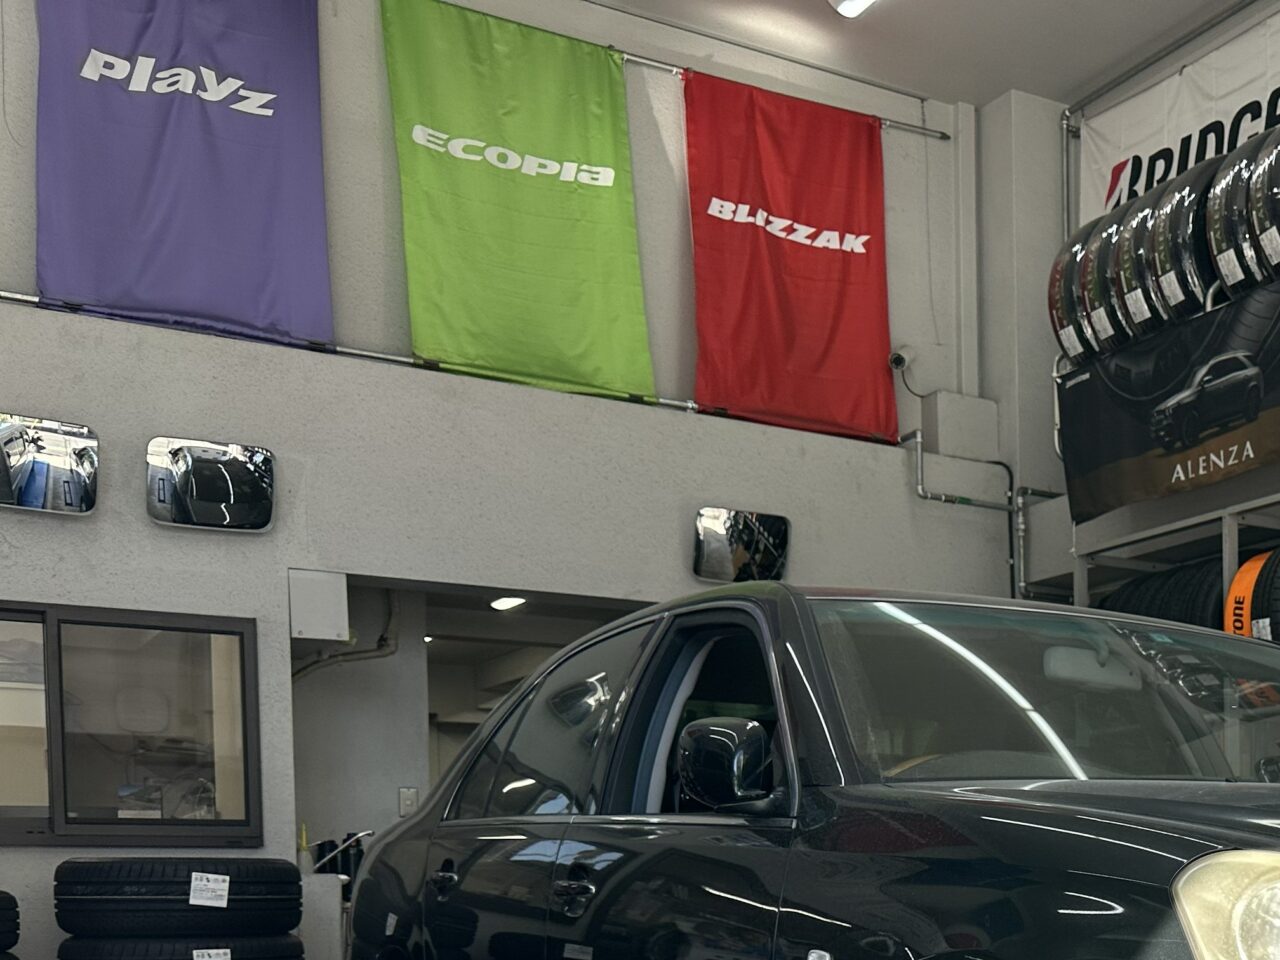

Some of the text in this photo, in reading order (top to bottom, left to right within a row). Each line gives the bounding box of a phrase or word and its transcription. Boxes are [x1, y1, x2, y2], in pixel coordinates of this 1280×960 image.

[79, 48, 278, 116] Playz
[706, 196, 871, 254] BLIZZAK
[1171, 440, 1255, 484] ALENZA
